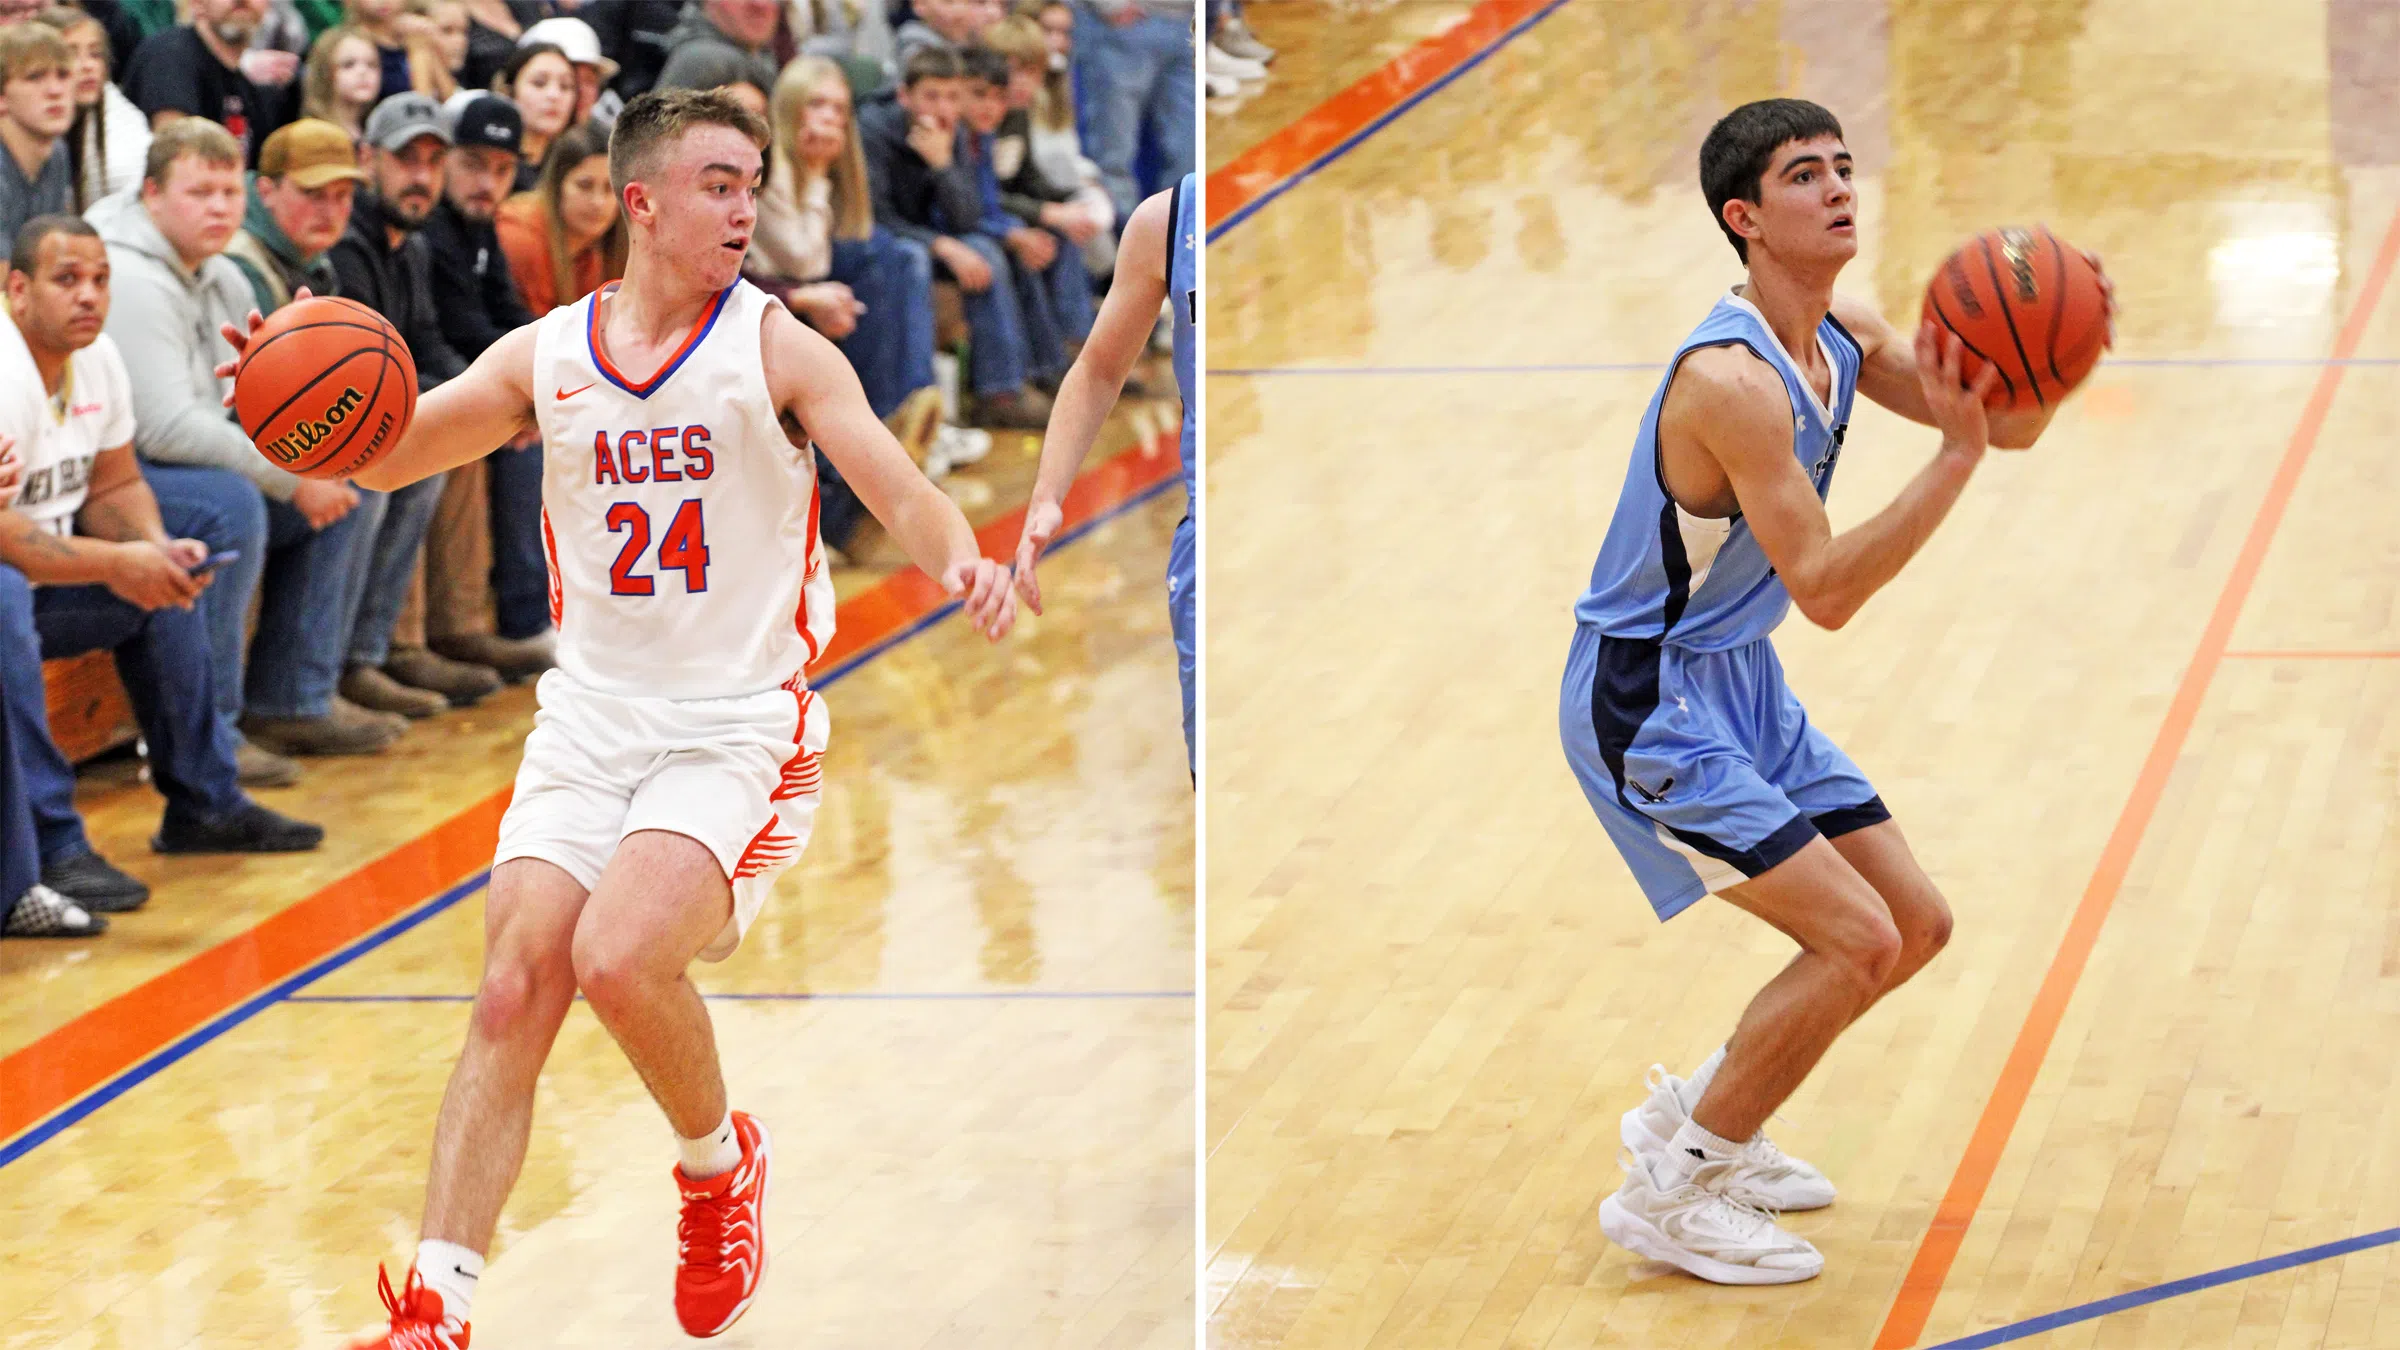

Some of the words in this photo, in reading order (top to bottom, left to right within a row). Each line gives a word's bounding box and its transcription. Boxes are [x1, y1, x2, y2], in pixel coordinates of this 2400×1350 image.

[265, 386, 365, 464] Wilson
[594, 424, 715, 485] ACES
[605, 498, 711, 597] 24
